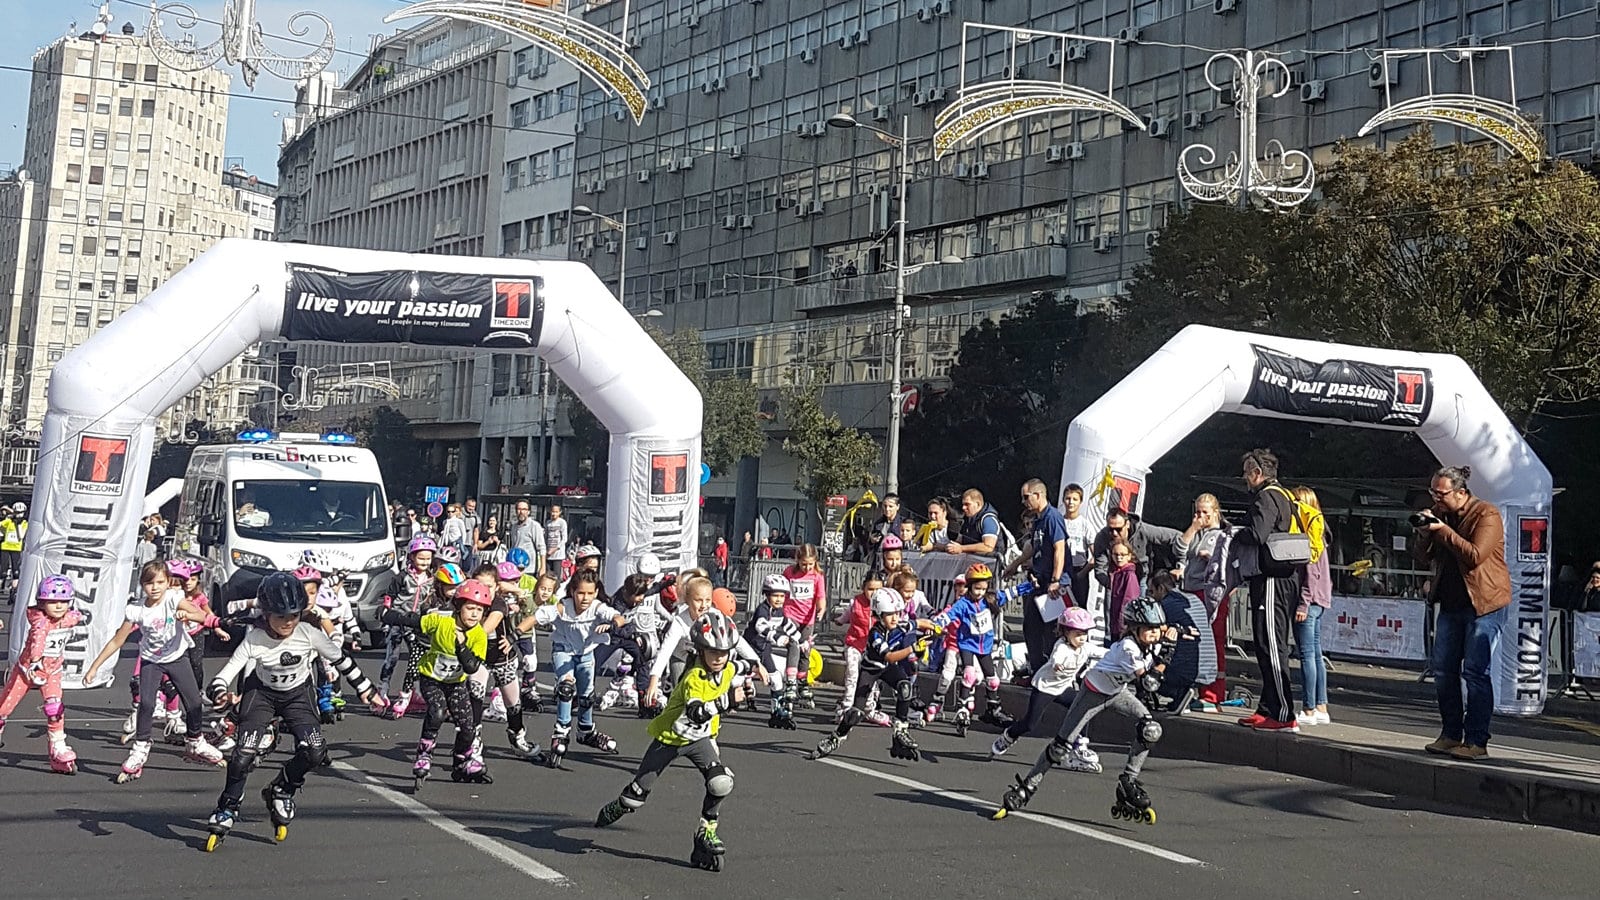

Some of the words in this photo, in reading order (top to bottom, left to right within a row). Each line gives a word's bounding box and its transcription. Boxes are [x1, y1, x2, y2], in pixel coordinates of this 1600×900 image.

[296, 292, 339, 313] live
[343, 299, 396, 317] your
[397, 300, 483, 318] passion
[496, 282, 531, 318] T
[1259, 367, 1288, 388] live
[1290, 379, 1327, 394] your
[1326, 381, 1388, 401] passion
[1397, 373, 1423, 404] T
[80, 436, 128, 482] T
[73, 482, 121, 493] TIMEZONE
[652, 454, 687, 494] T
[651, 495, 687, 503] TIMEZONE
[1521, 520, 1547, 552] T
[1338, 611, 1358, 629] dip
[1376, 614, 1402, 633] dip
[1516, 567, 1545, 701] TIMEZONE
[49, 637, 66, 649] 29
[270, 673, 297, 684] 373
